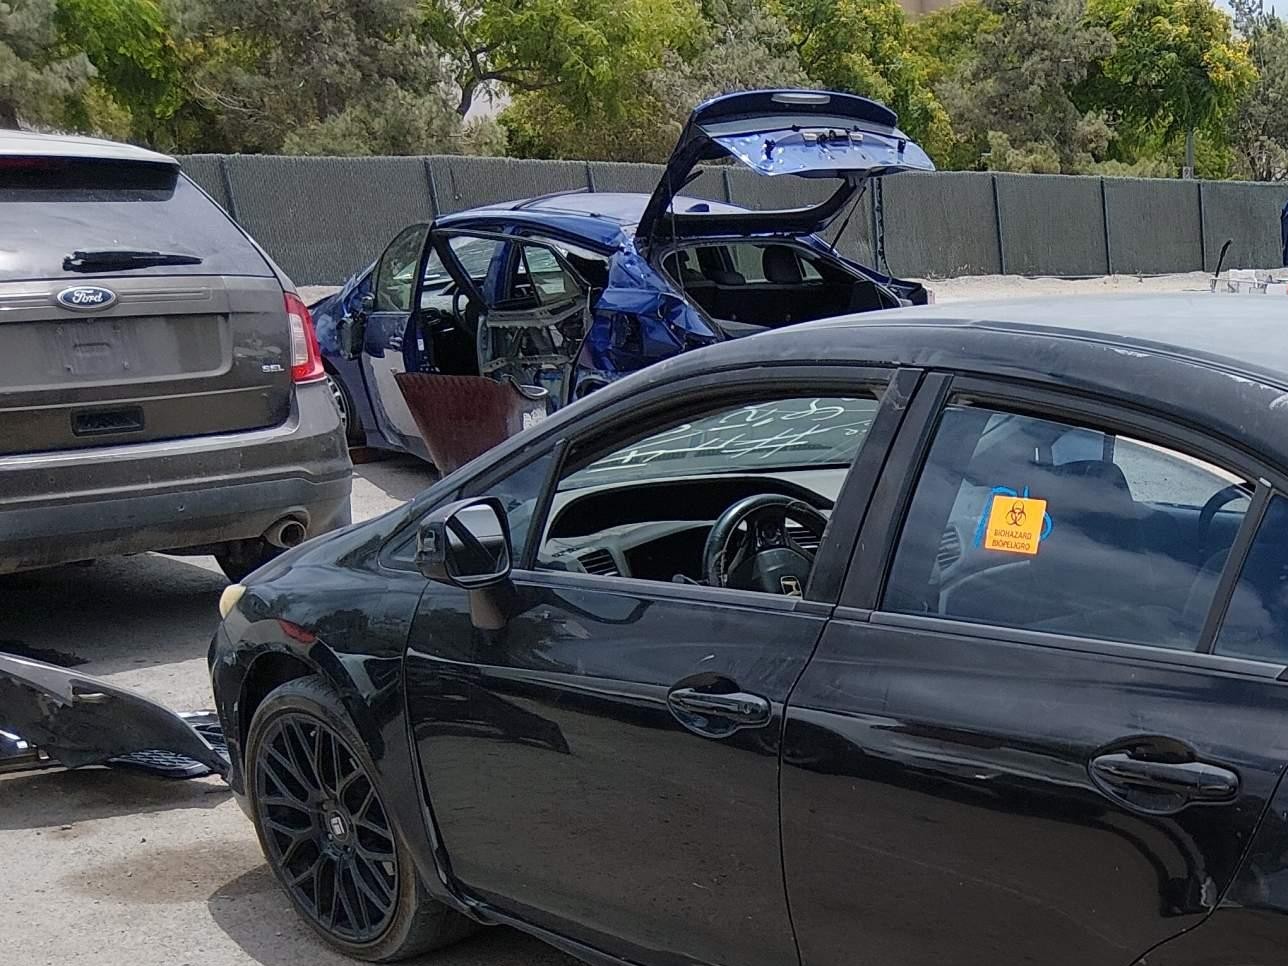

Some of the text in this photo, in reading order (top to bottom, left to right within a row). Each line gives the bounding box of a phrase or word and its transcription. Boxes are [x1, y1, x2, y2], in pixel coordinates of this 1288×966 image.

[72, 289, 103, 303] Ford
[261, 364, 285, 373] SEL
[993, 528, 1033, 540] BIOHAZARD
[991, 539, 1031, 551] BIOPELIGRO
